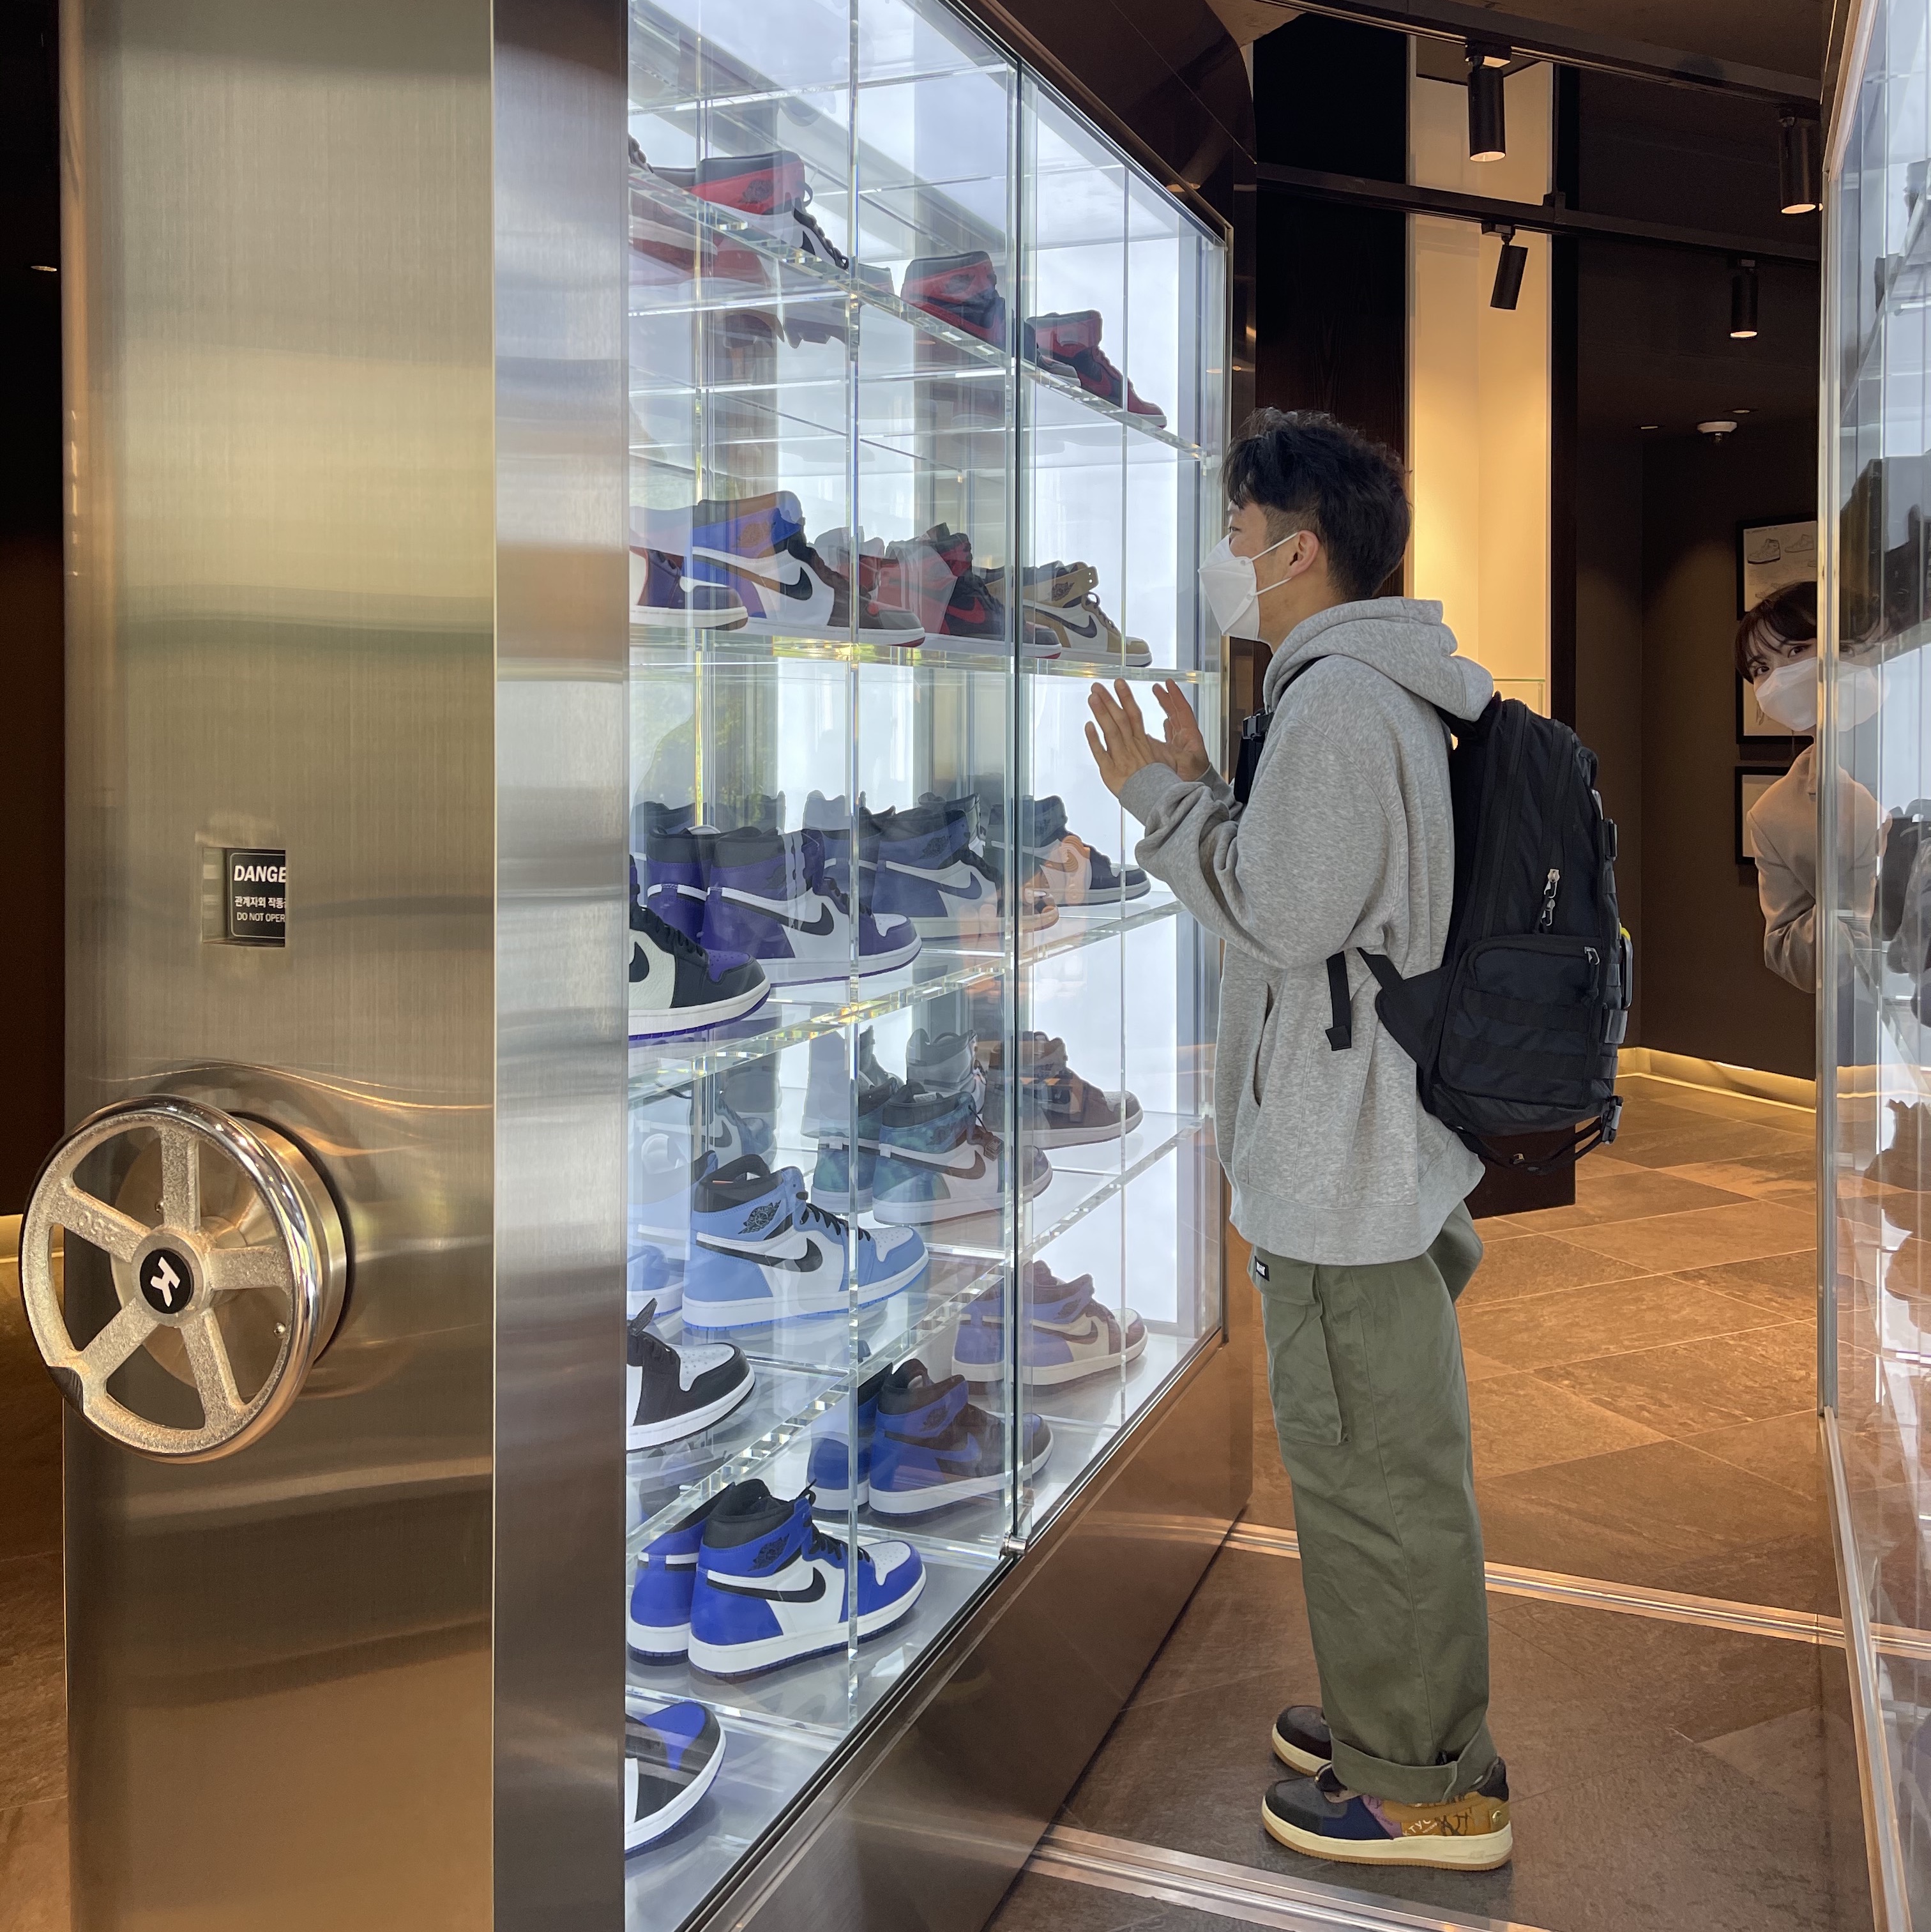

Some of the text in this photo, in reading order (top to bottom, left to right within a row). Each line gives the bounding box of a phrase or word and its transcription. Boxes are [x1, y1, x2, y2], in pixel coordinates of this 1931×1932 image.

[234, 865, 286, 883] DANGE
[234, 896, 266, 908] 관계자외
[236, 912, 248, 920] DO
